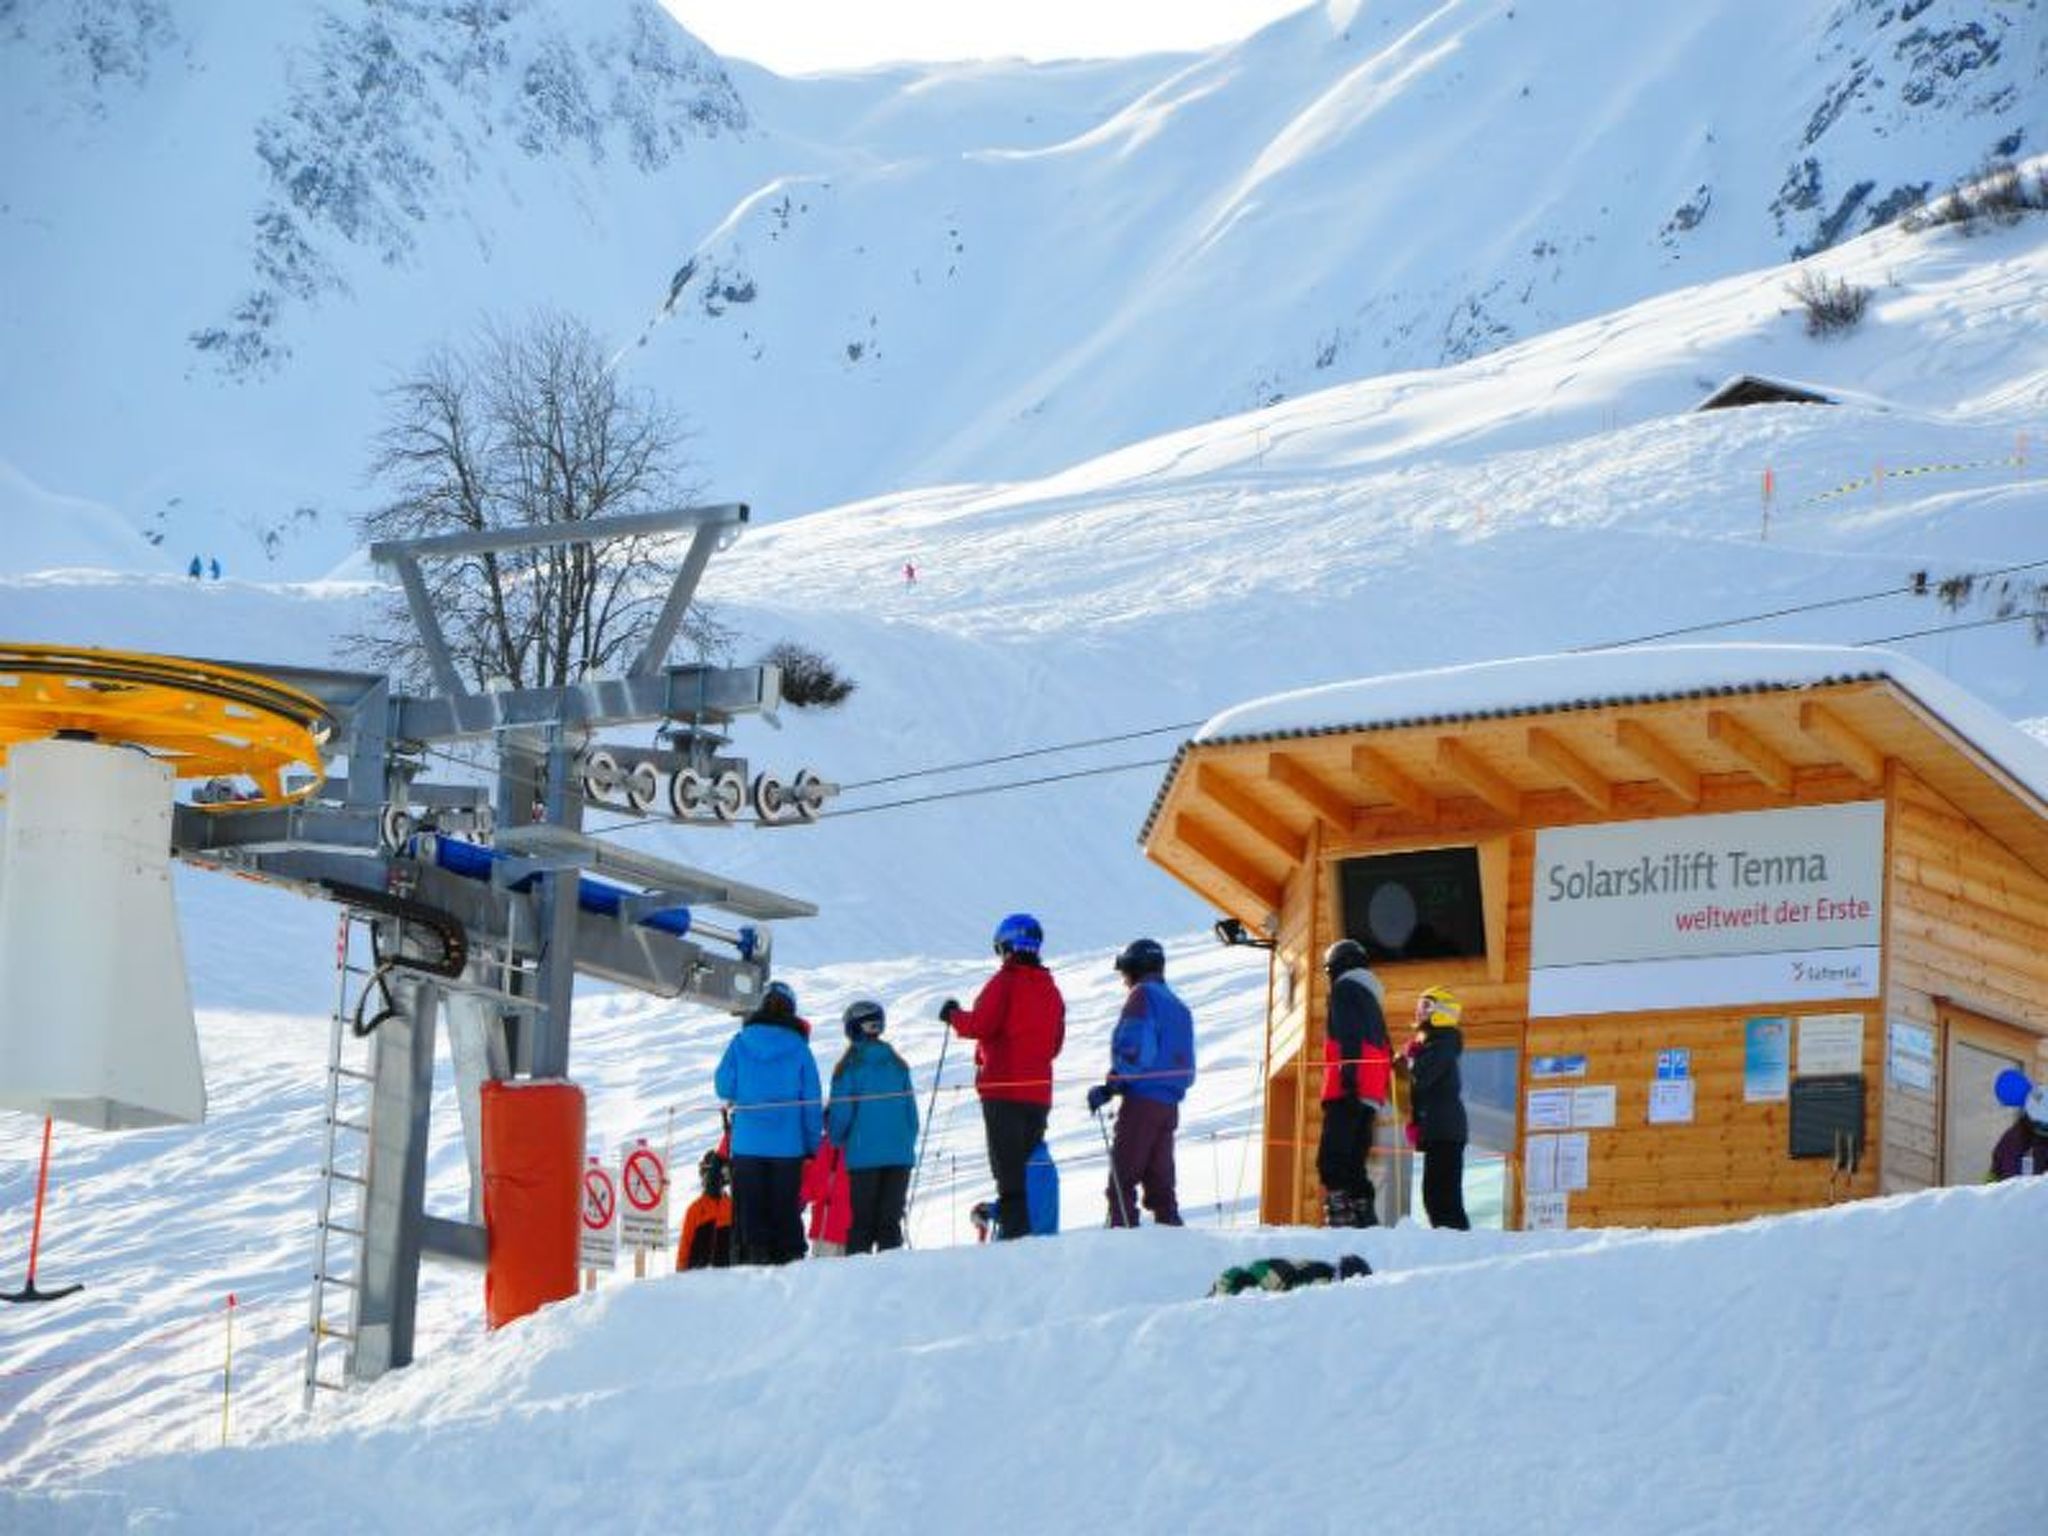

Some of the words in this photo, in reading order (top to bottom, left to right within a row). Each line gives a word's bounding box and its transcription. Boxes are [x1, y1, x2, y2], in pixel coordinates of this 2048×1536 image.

[1547, 852, 1718, 902] Solarskilift
[1728, 853, 1828, 888] Tenna
[1676, 904, 1769, 932] weltweit
[1774, 901, 1811, 925] der
[1817, 896, 1871, 921] Erste
